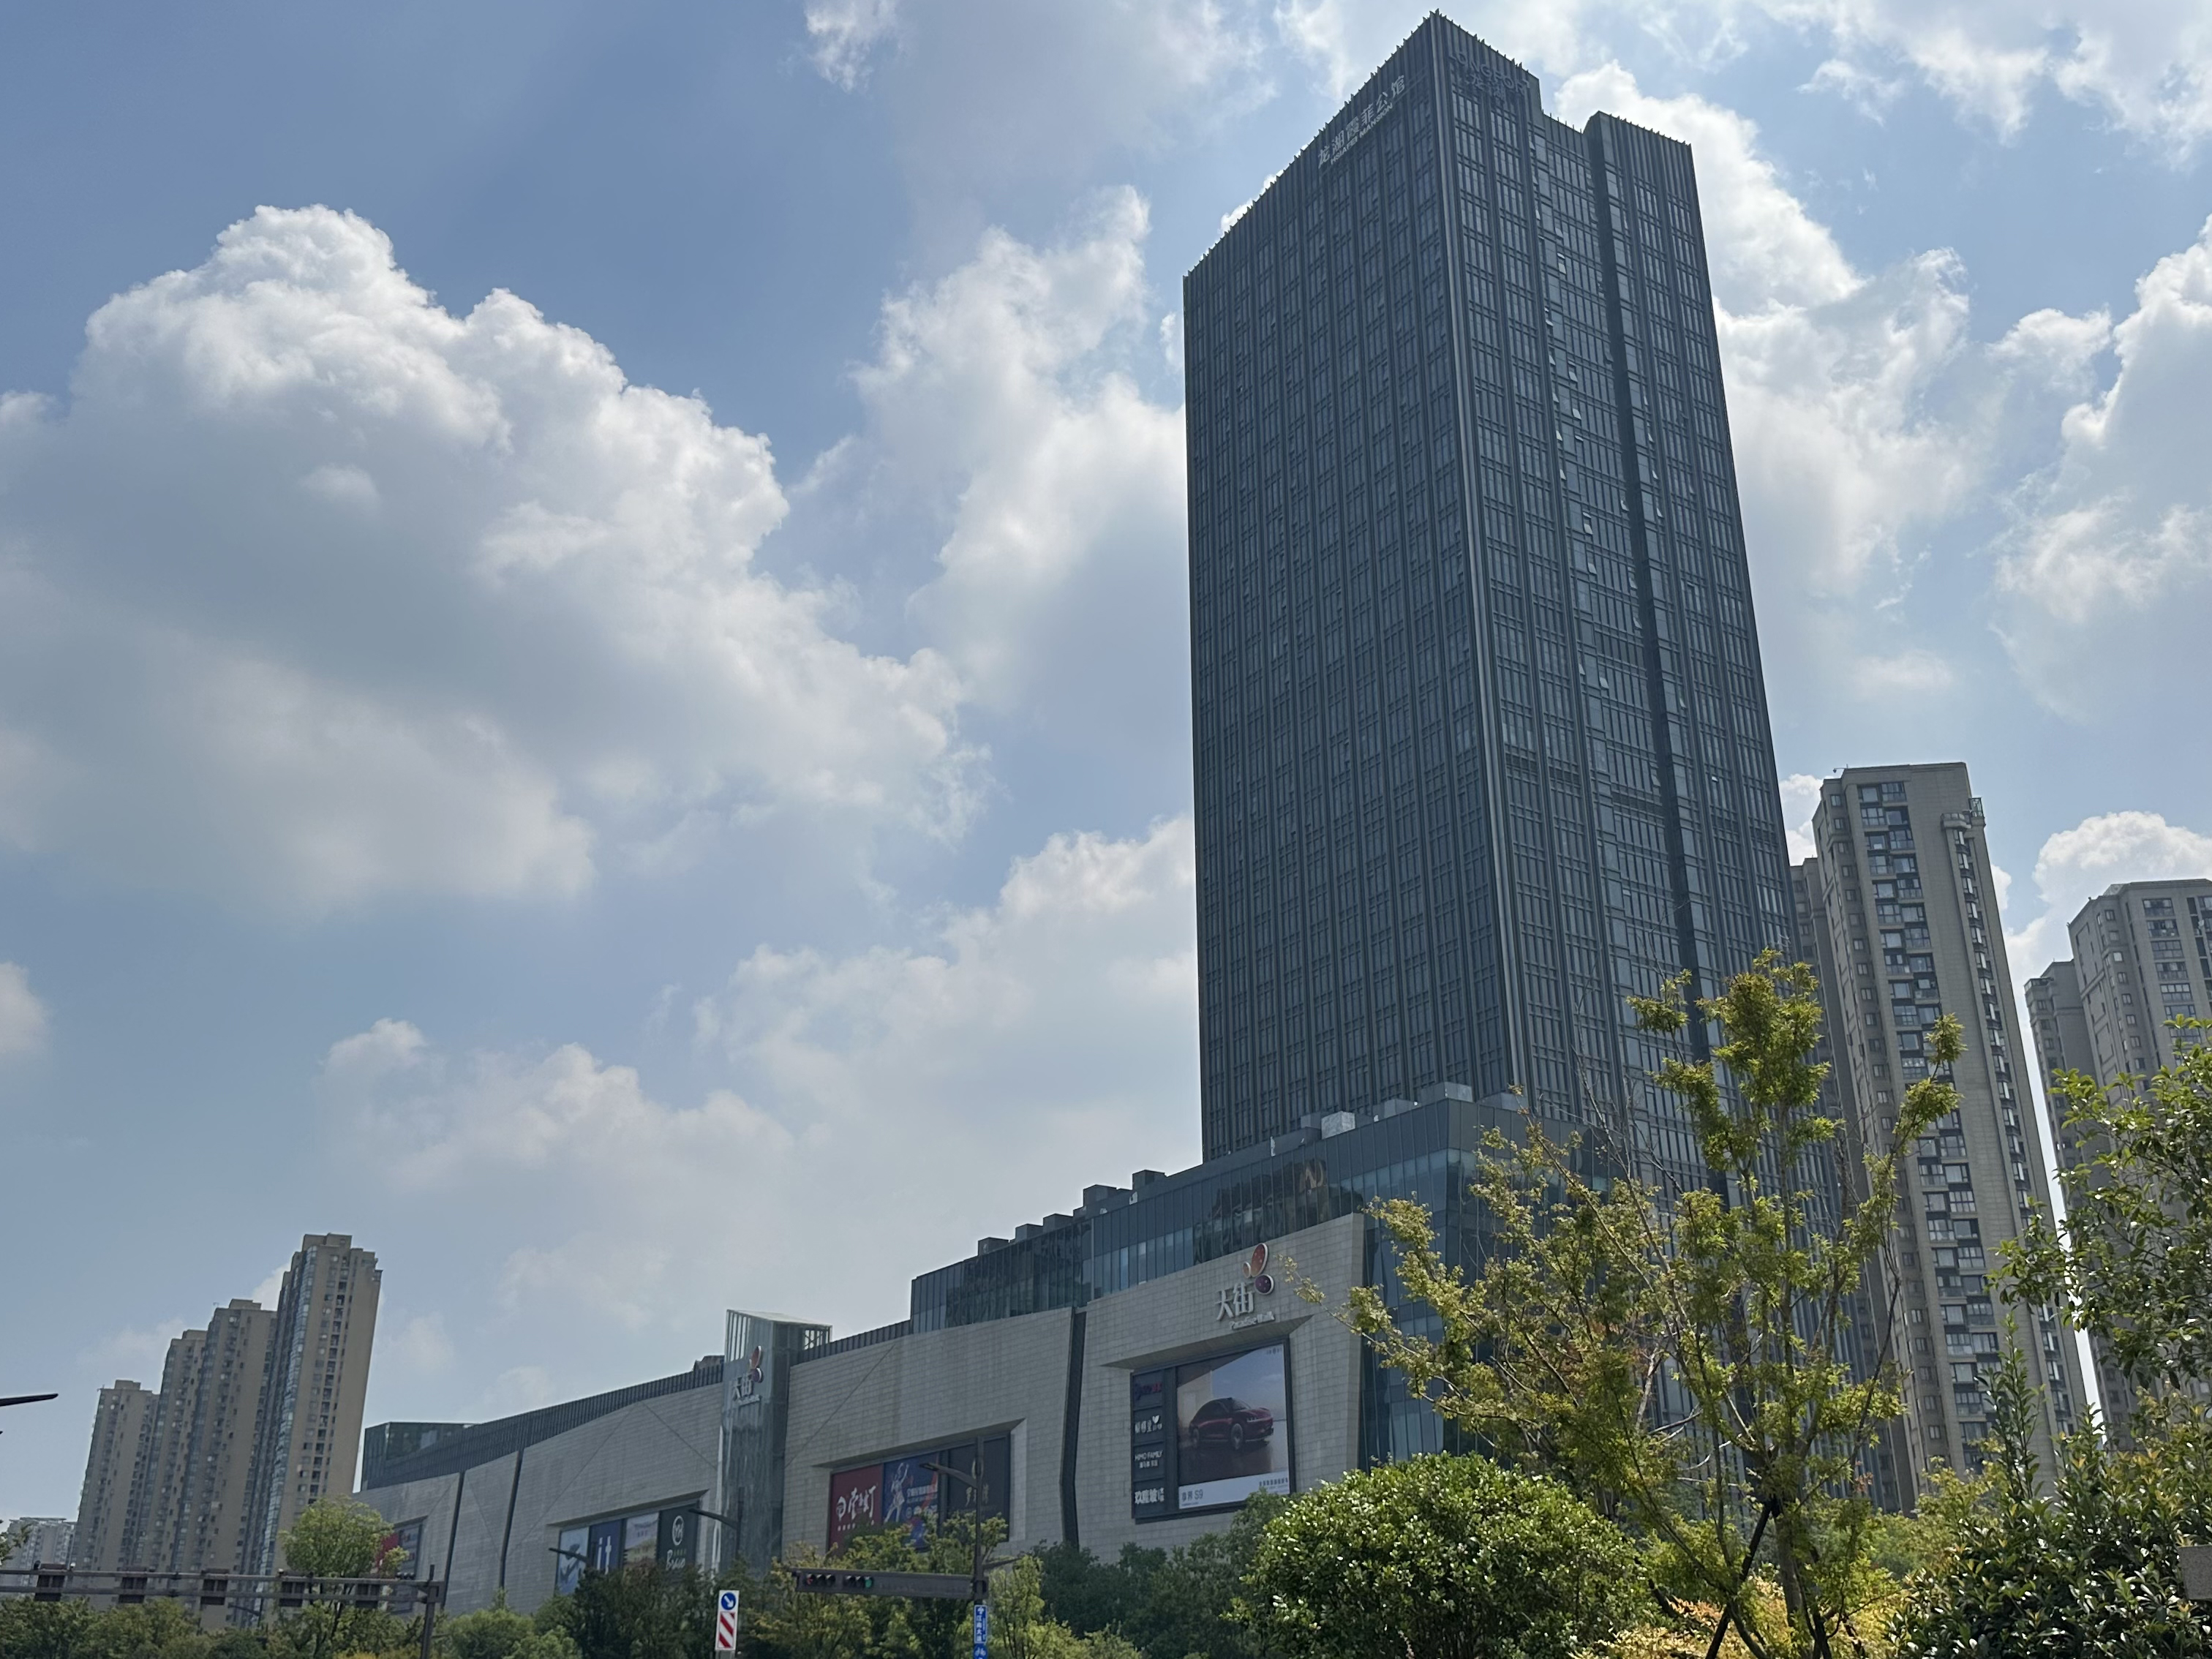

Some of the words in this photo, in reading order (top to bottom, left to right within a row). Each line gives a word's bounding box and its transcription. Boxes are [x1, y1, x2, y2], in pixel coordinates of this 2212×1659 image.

[1318, 75, 1404, 169] 龙湖霞菲公馆
[1331, 136, 1358, 165] HSIAFEI
[1359, 102, 1393, 138] MANSION
[1214, 1282, 1254, 1320] 天街
[1194, 1489, 1203, 1500] S9
